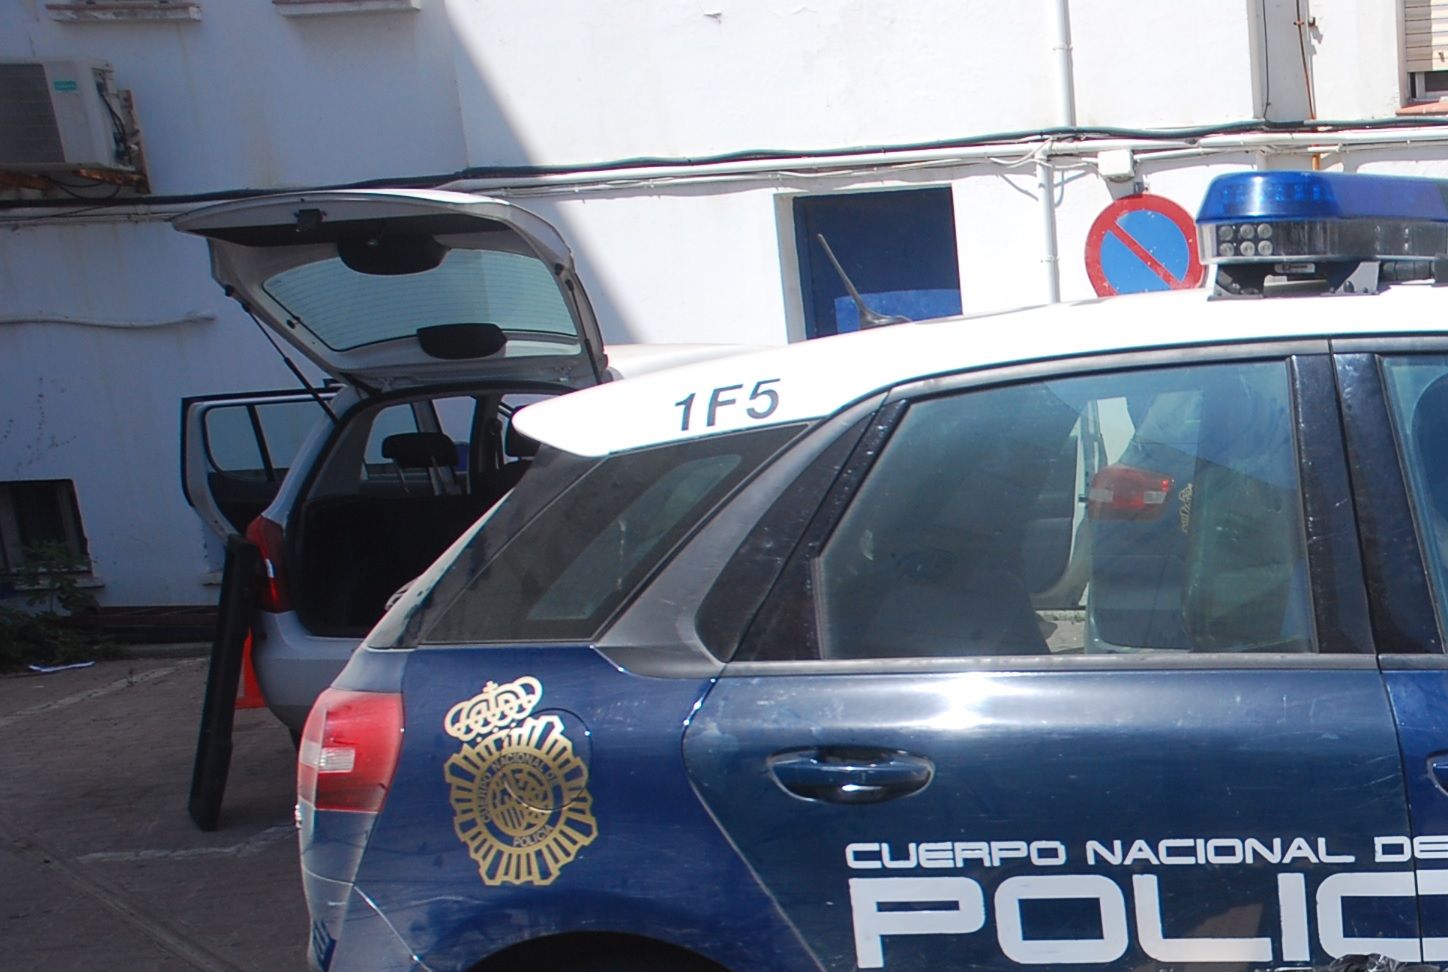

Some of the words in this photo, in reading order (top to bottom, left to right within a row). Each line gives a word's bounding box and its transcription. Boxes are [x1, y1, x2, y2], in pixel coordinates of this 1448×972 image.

[674, 377, 781, 432] 1F5
[845, 840, 1067, 869] CUERPO
[1085, 836, 1355, 866] NACIONAL
